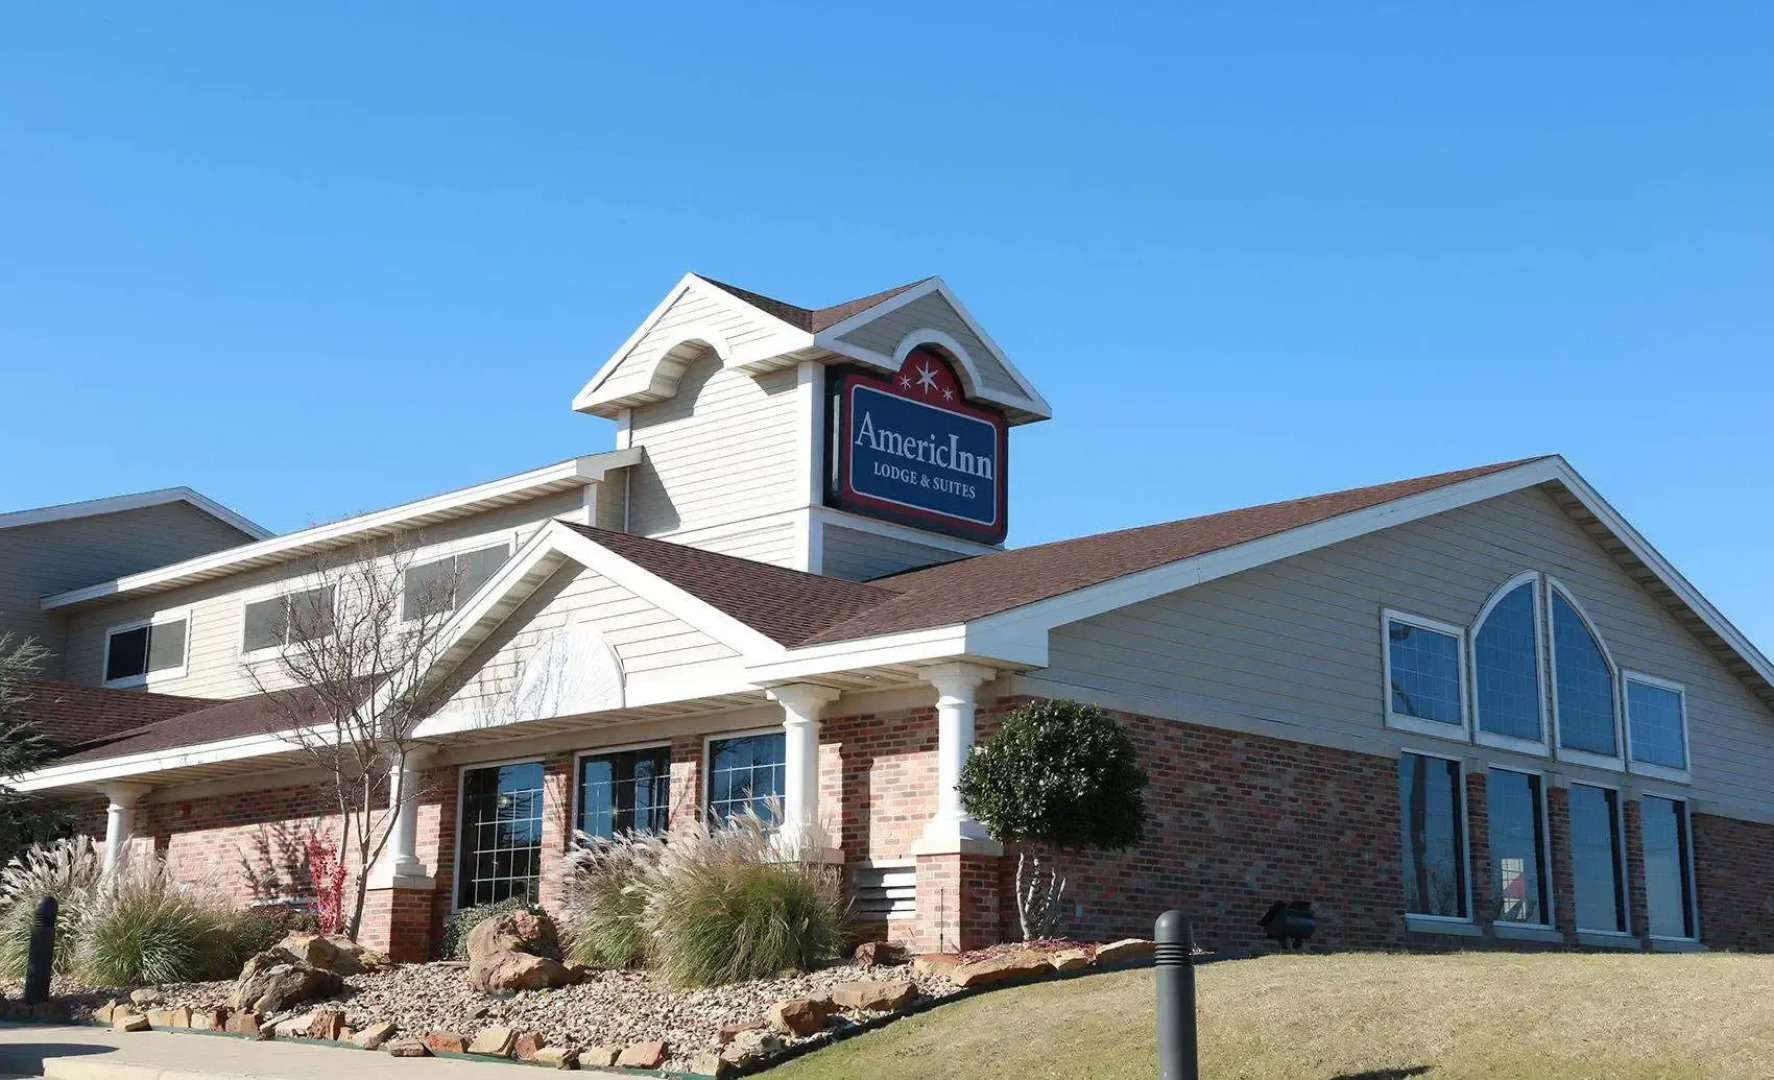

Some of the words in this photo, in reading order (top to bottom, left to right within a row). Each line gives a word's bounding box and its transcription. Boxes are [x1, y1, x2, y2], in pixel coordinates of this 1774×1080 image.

[854, 411, 993, 480] AmericInn
[874, 461, 917, 485] LODGE
[920, 474, 931, 489] &
[932, 477, 976, 499] SUITES
